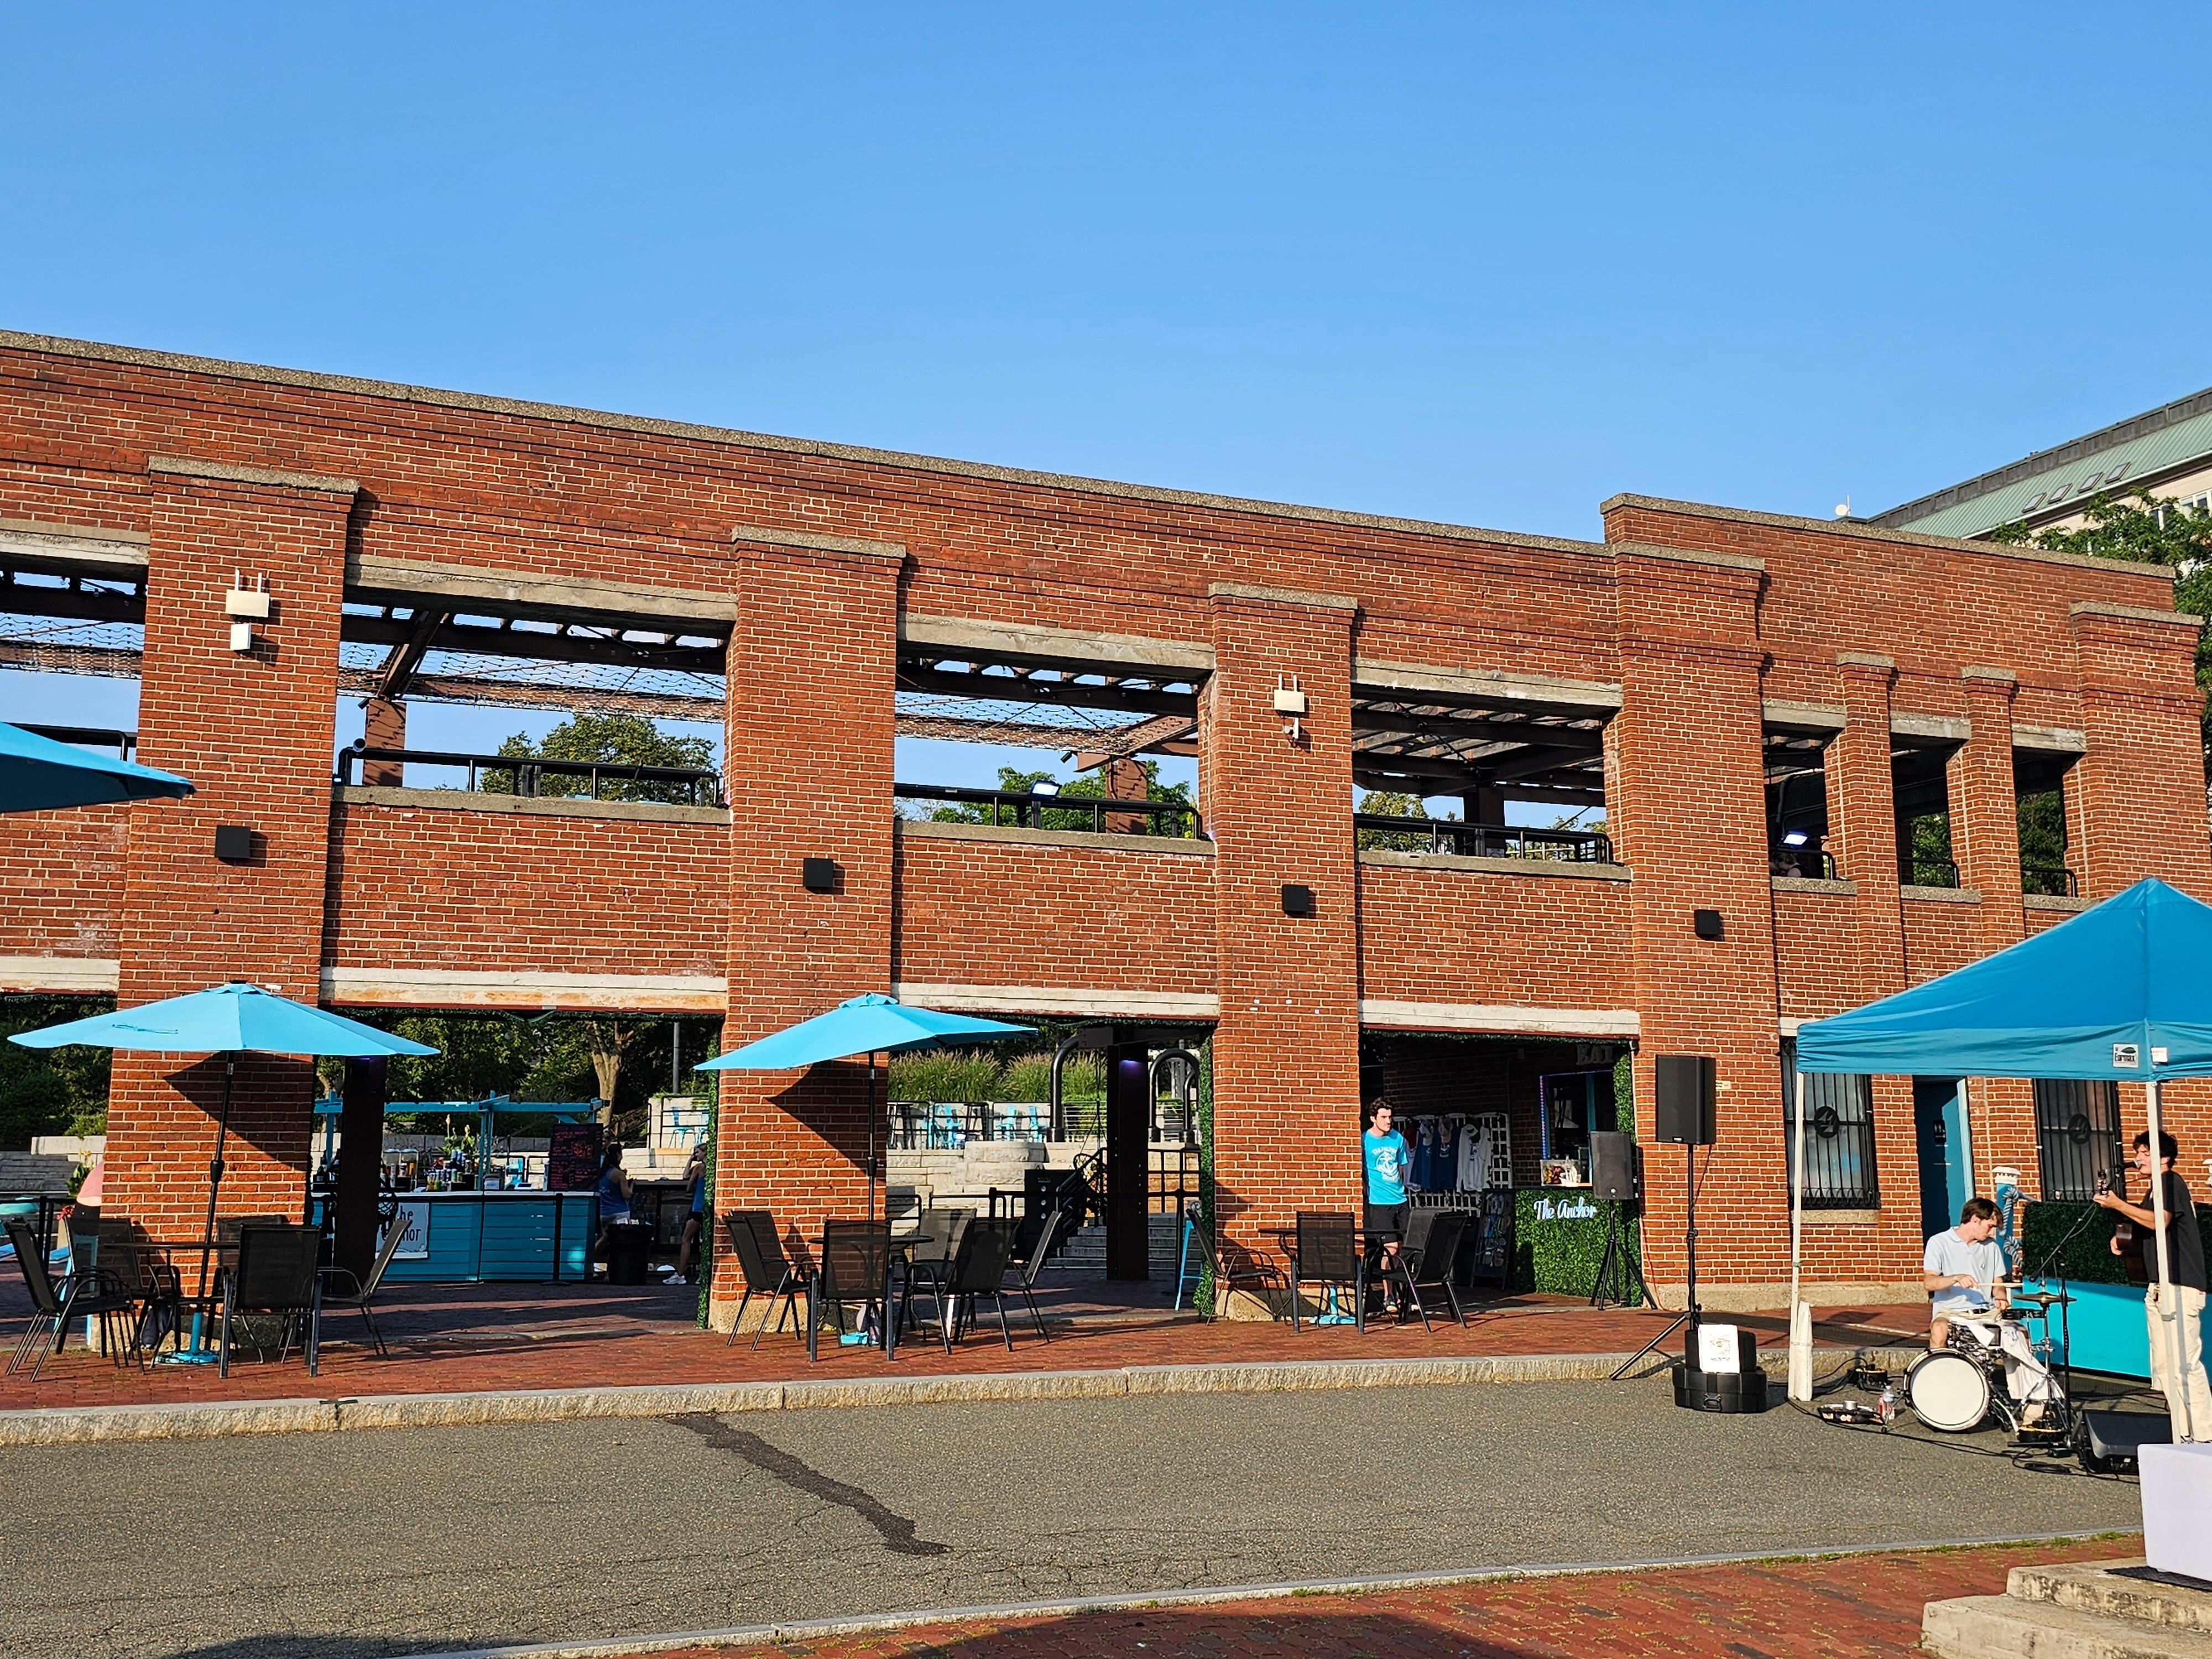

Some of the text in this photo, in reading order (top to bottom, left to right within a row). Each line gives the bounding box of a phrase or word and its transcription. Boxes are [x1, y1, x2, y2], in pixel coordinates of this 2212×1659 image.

[1575, 1044, 1614, 1065] EAT
[400, 1205, 414, 1220] he
[1533, 1196, 1598, 1220] The Anchor
